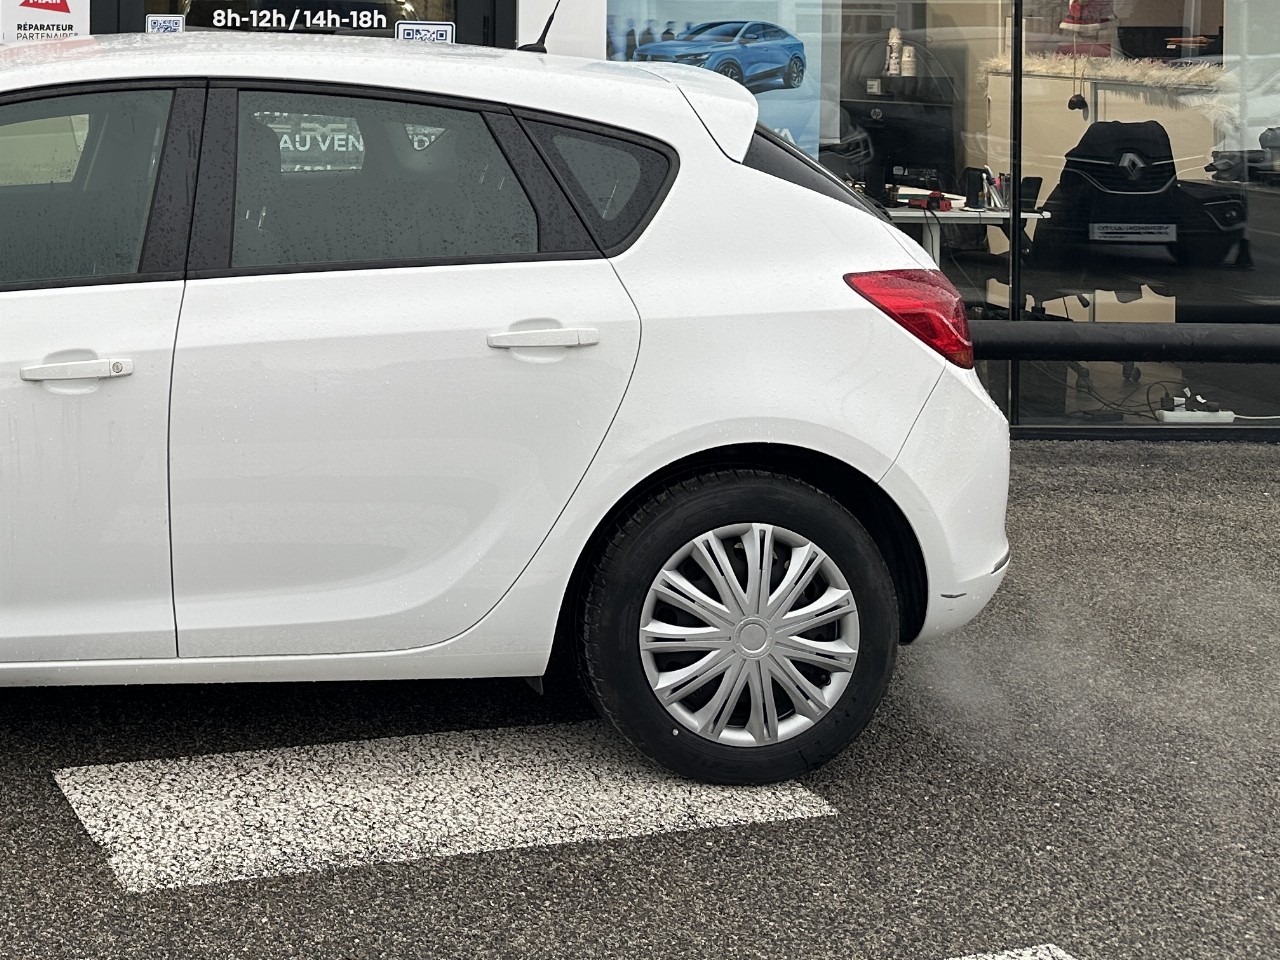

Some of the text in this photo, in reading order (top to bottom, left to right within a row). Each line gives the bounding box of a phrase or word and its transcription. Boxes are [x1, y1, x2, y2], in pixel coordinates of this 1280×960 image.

[16, 21, 74, 31] RÉPARATEUR
[212, 9, 286, 28] 8h-12h
[303, 9, 387, 29] 14h-18h
